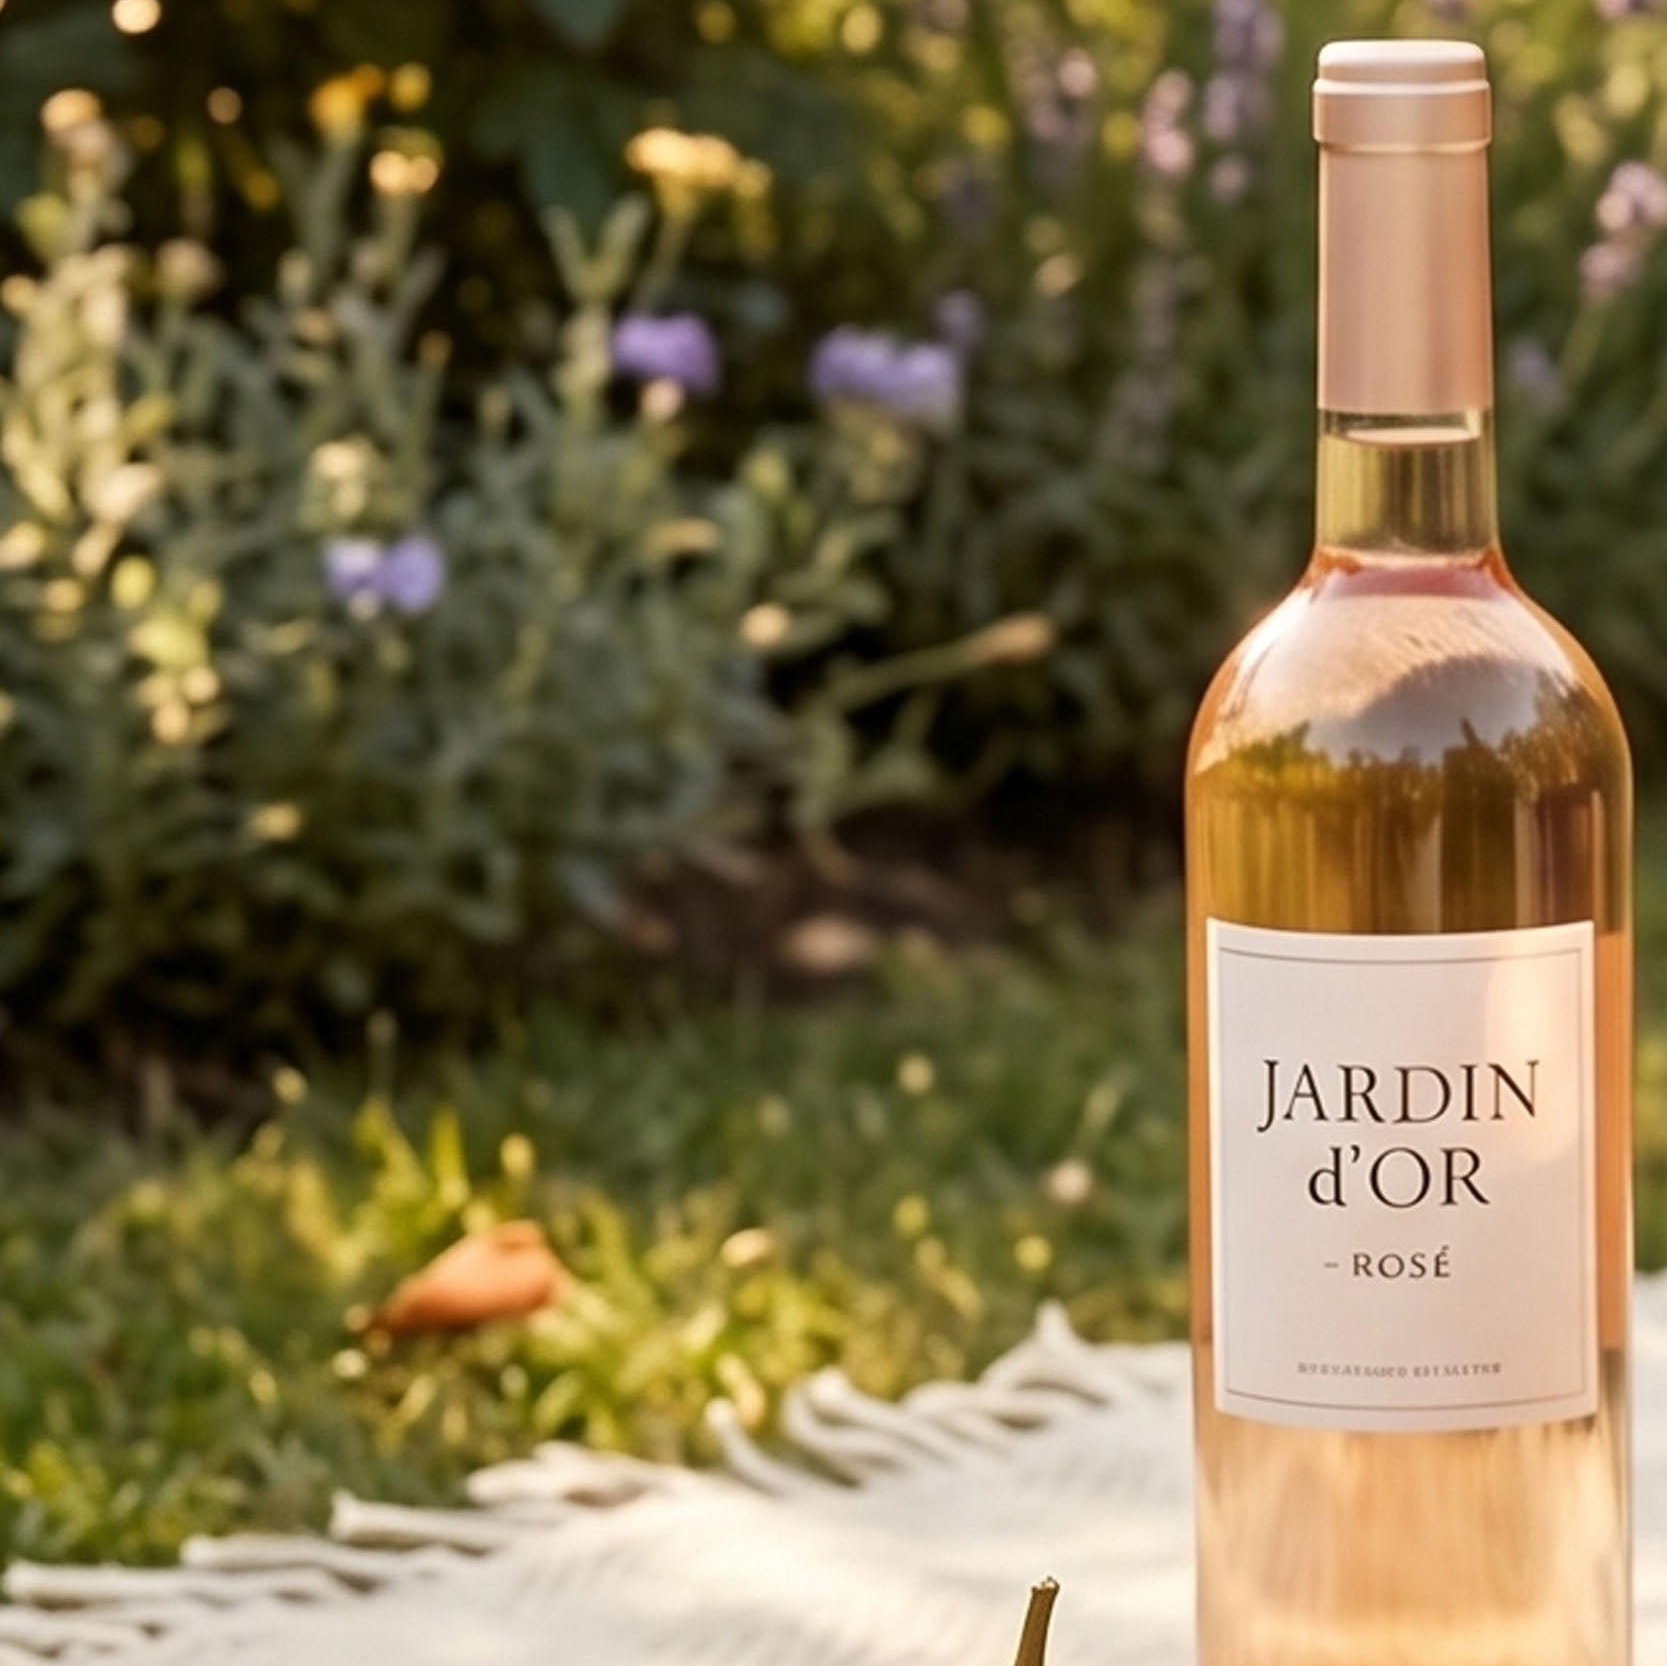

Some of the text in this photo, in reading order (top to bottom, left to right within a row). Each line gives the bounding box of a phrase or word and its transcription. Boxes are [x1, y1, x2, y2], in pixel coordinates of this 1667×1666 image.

[1256, 1059, 1540, 1133] JARDIN
[1307, 1144, 1490, 1209] d'OR
[1352, 1245, 1452, 1279] ROSÉ
